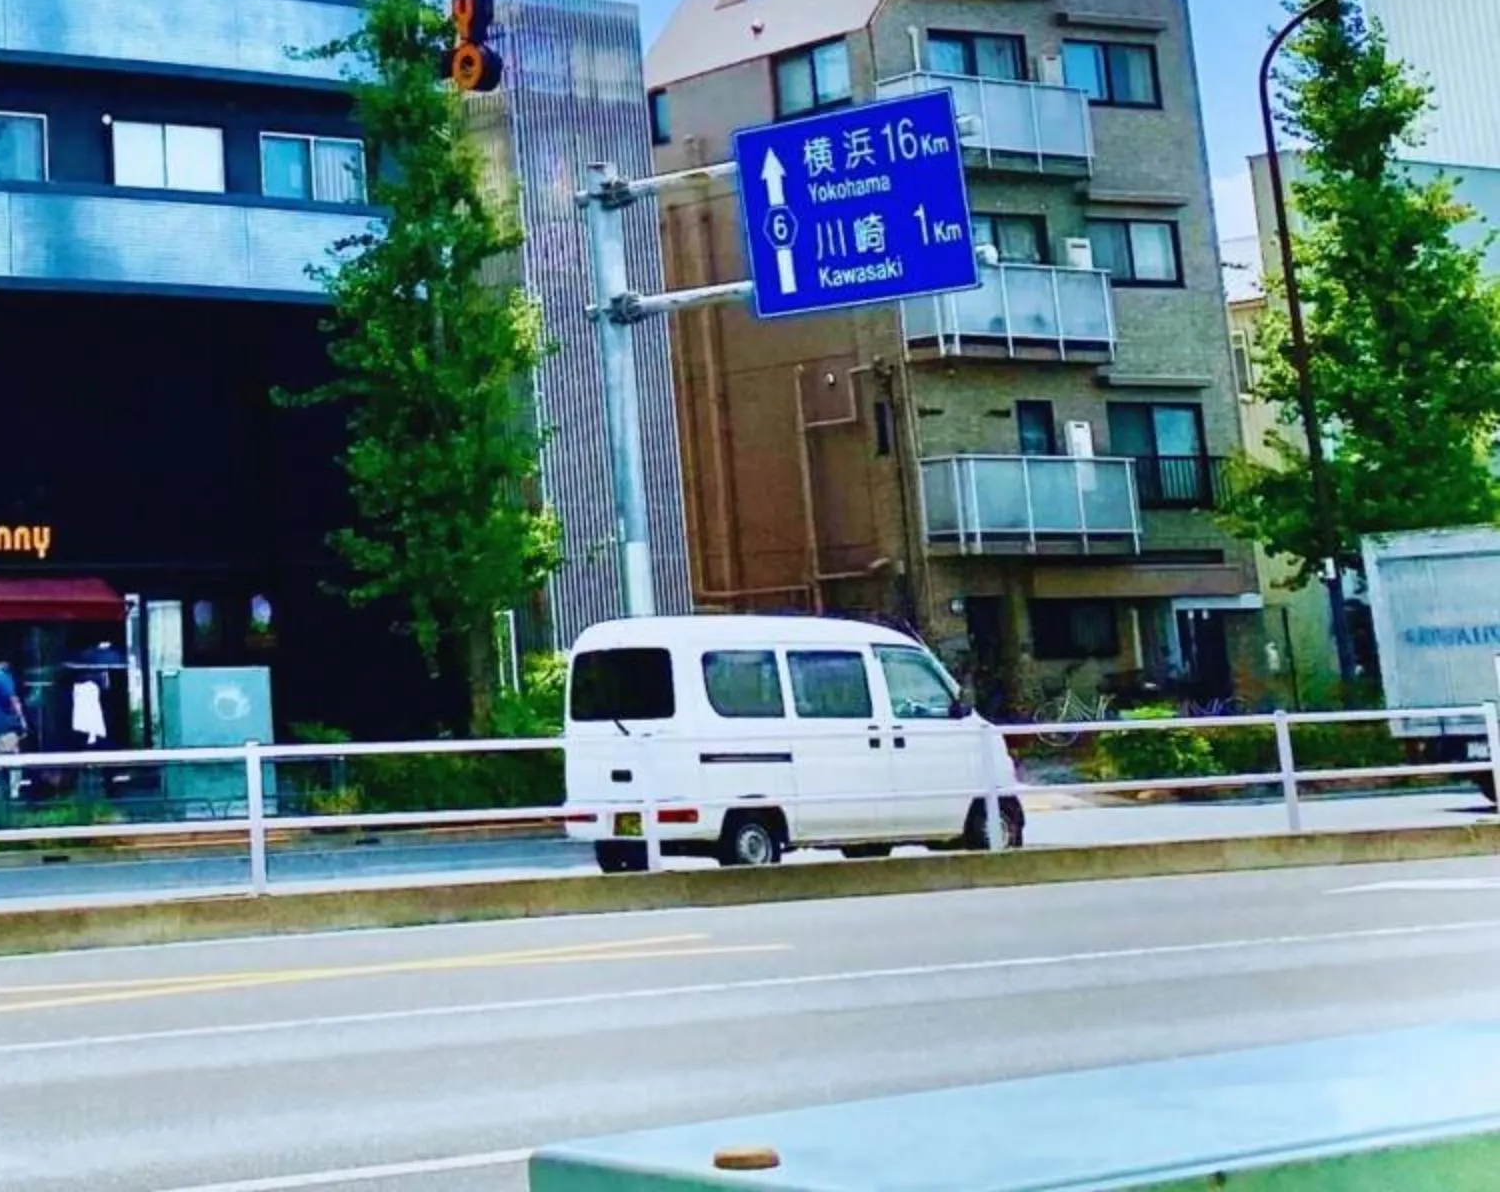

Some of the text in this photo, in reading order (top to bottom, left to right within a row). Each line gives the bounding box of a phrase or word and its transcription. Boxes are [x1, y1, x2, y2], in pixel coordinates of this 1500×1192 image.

[803, 128, 876, 178] 横浜
[807, 174, 891, 204] Yokohama
[773, 215, 787, 240] 6
[816, 213, 886, 261] 川崎
[818, 256, 903, 288] Kawasaki
